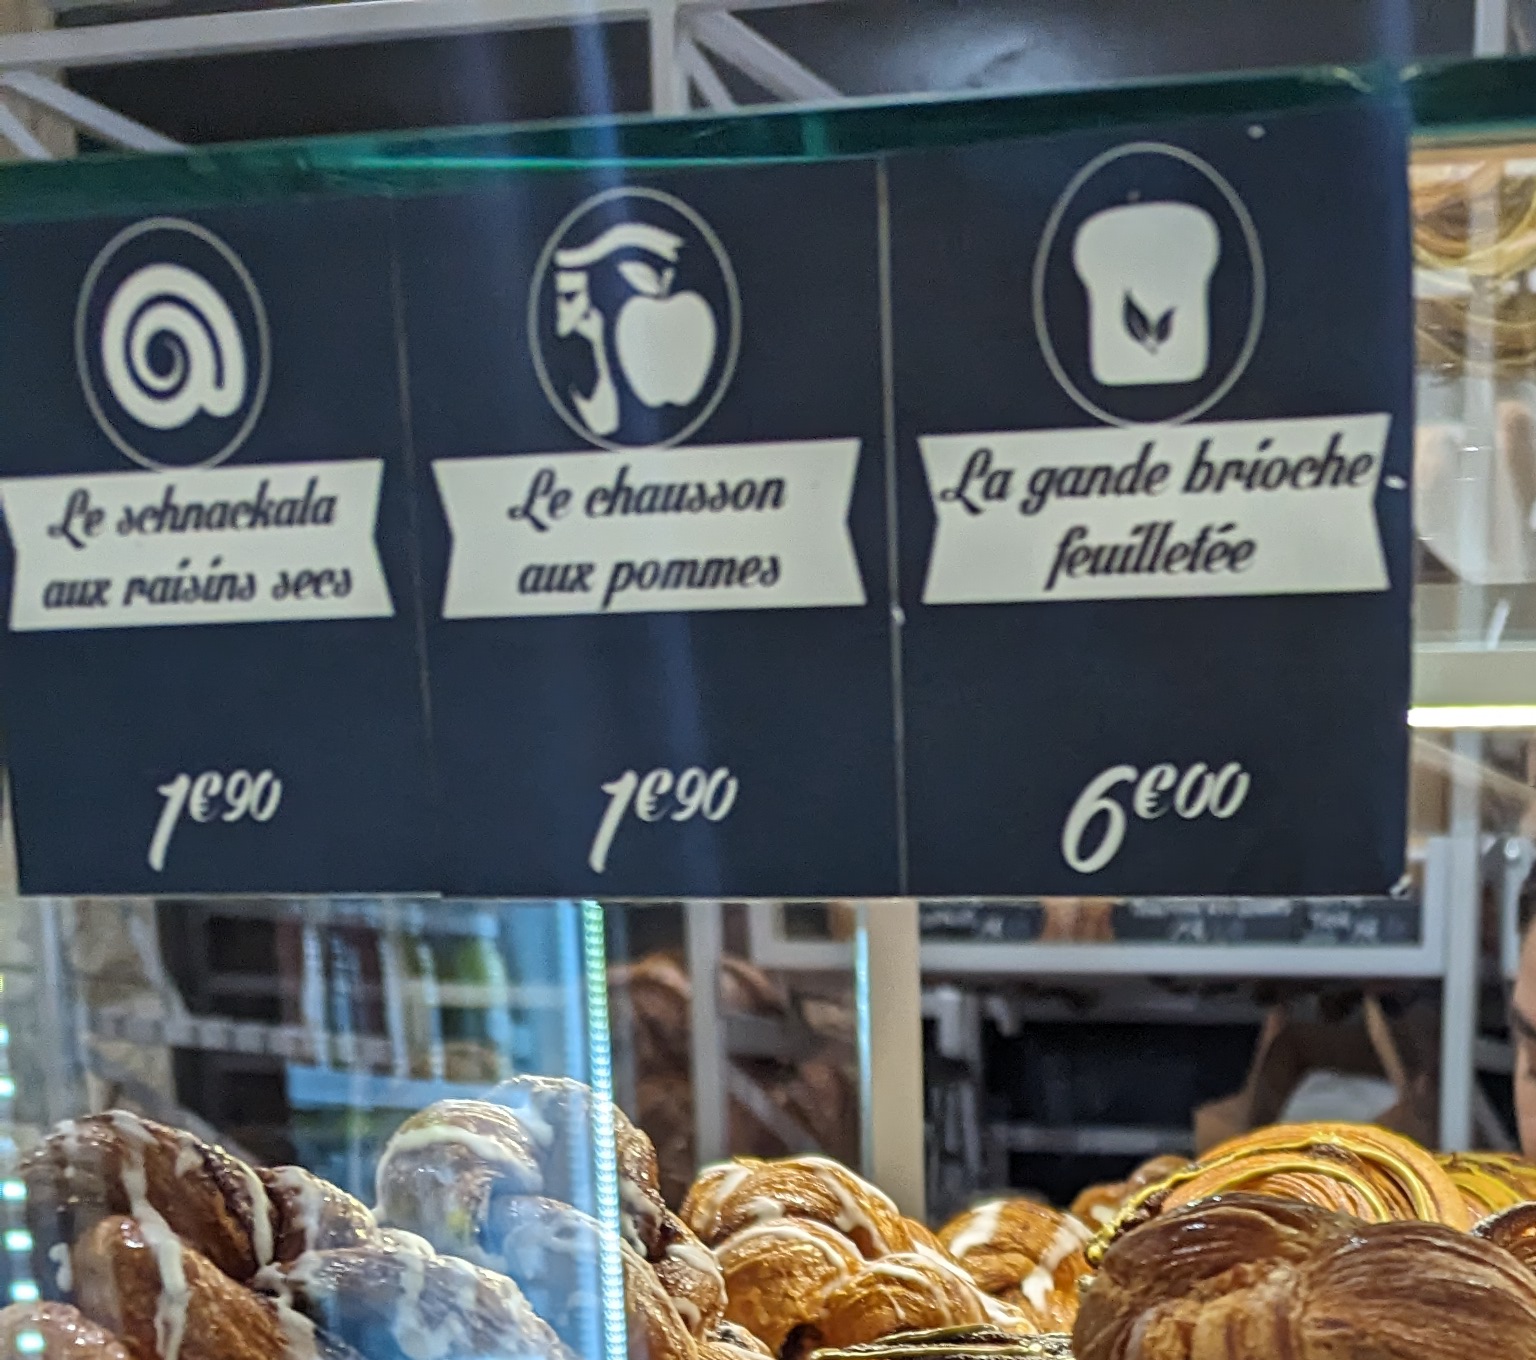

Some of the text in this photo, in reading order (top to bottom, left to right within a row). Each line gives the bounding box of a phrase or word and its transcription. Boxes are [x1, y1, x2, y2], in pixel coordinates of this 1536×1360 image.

[508, 465, 786, 532] Le chausson
[939, 432, 1374, 516] La gande brioche
[48, 478, 337, 549] Le schnackala
[43, 557, 352, 609] aux raisins secs
[518, 555, 780, 610] aux pommes
[1044, 521, 1256, 591] feuilletée
